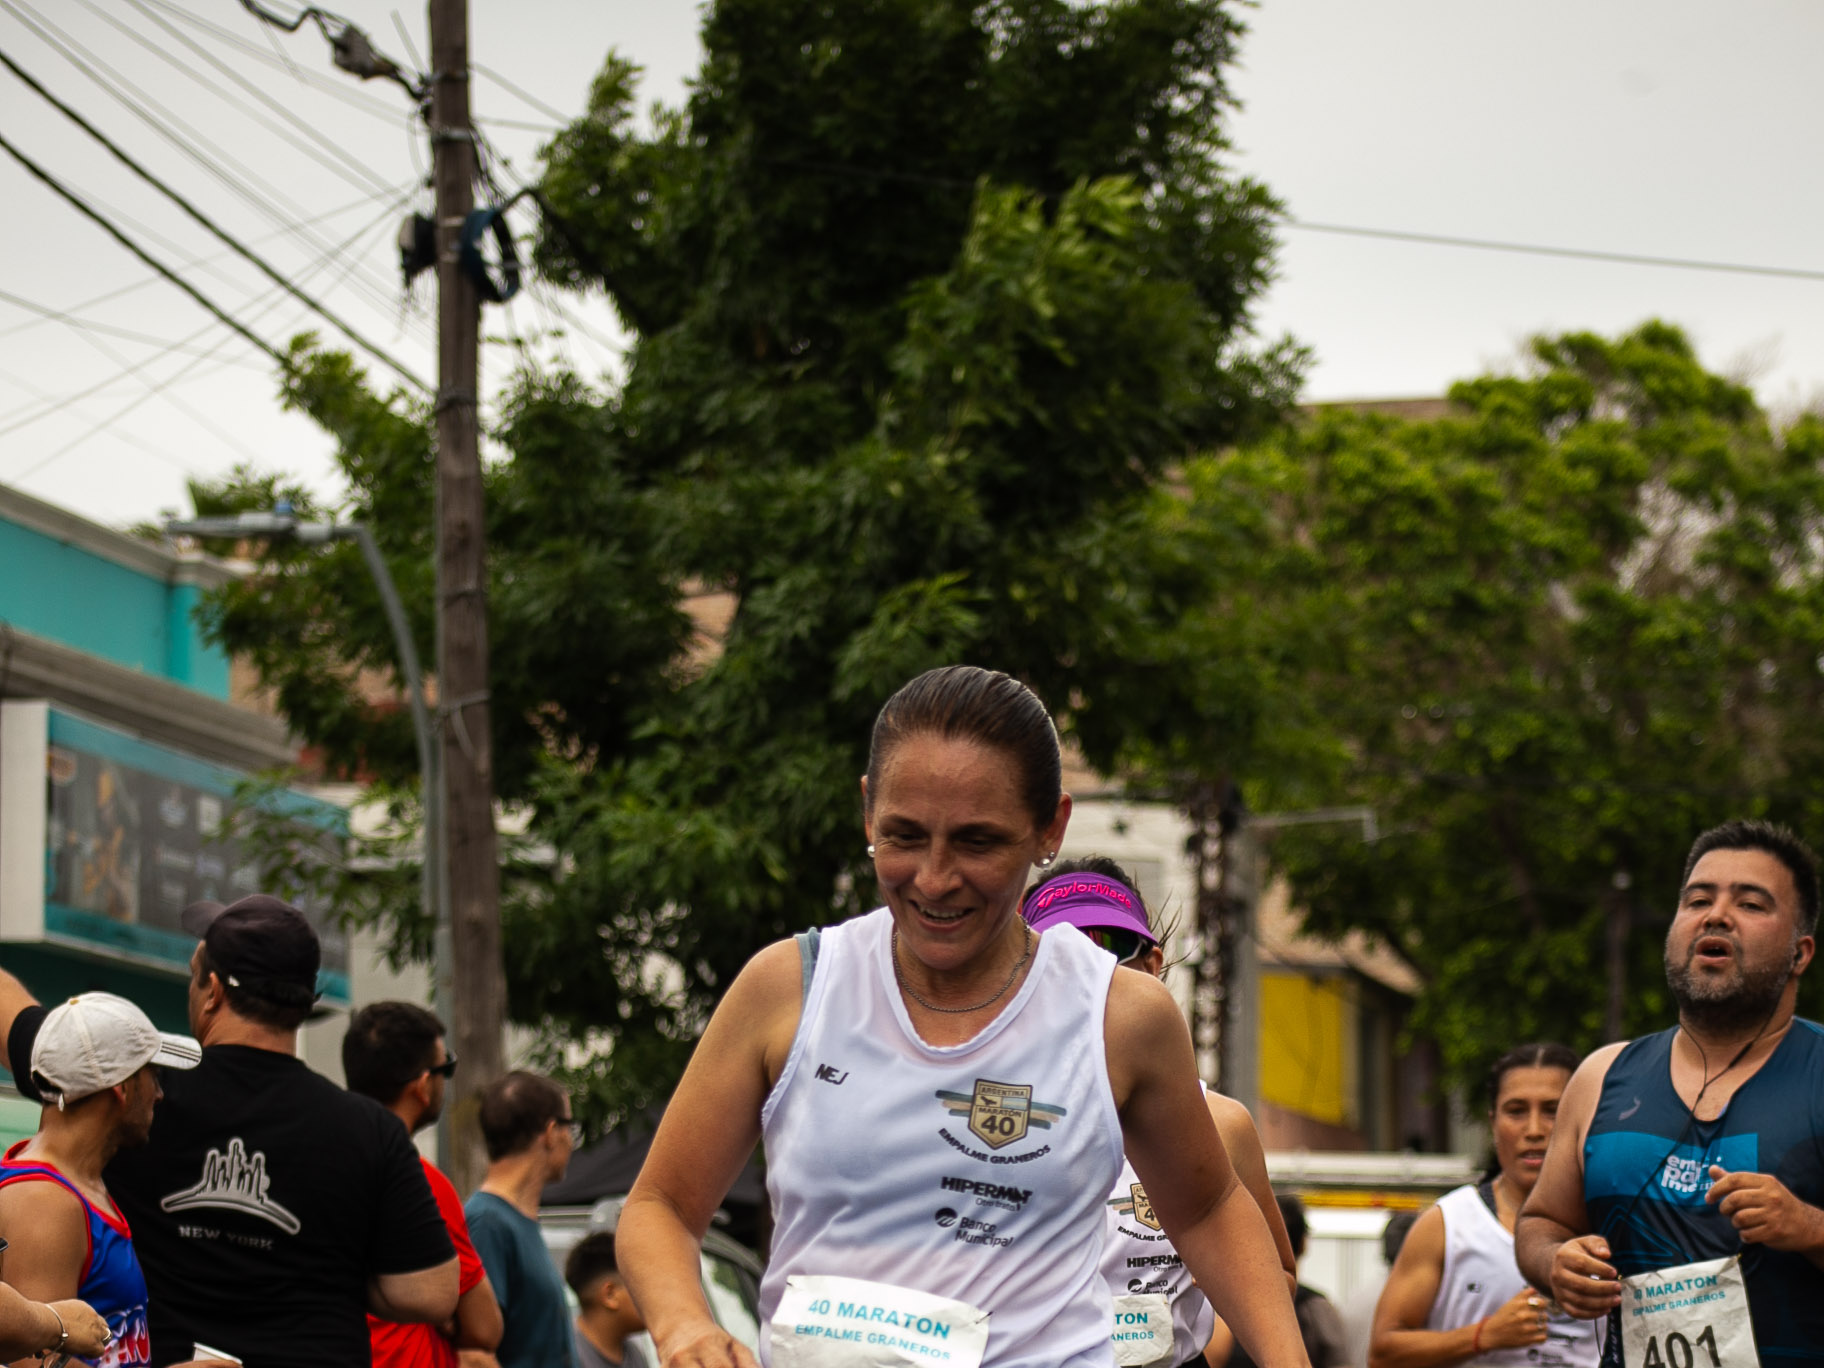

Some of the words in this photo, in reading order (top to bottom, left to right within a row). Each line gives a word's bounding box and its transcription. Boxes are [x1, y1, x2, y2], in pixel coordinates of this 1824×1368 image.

[1037, 881, 1132, 909] TaylorMade
[981, 1115, 1015, 1136] 40
[938, 1127, 989, 1162] EMPALME
[990, 1144, 1051, 1165] GRANEROS
[959, 1216, 997, 1233] Banco
[1117, 1225, 1156, 1242] EMPALME
[178, 1225, 220, 1239] NEW
[226, 1232, 273, 1251] YORK
[955, 1229, 1015, 1248] Municipal
[1645, 1274, 1718, 1299] MARATON
[1668, 1290, 1726, 1310] GRANEROS
[807, 1299, 831, 1316] 40
[836, 1301, 952, 1341] MARATON
[794, 1323, 863, 1343] EMPALME
[866, 1331, 951, 1361] GRANEROS
